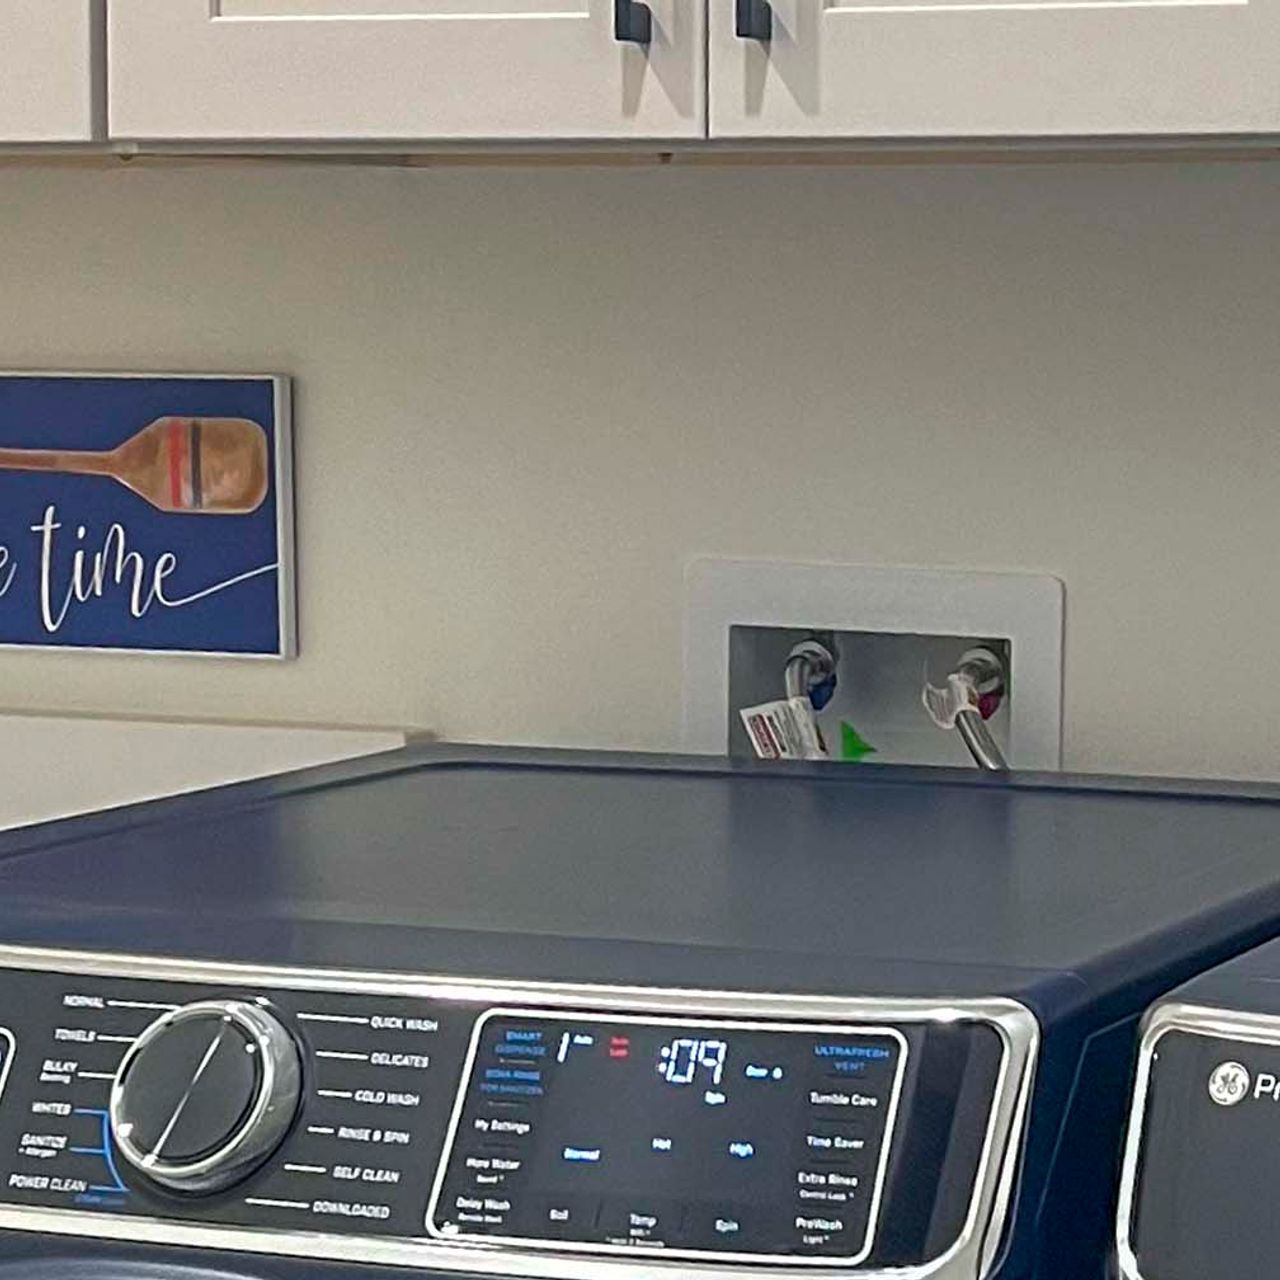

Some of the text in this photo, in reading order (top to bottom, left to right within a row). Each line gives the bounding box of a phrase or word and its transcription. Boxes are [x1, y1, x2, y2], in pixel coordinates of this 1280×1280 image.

[31, 505, 210, 633] time
[371, 1016, 438, 1032] QUICK WASH
[371, 1052, 429, 1069] DELICATES
[354, 1090, 420, 1106] COLD WASH
[810, 1091, 877, 1107] Tumble Care
[338, 1127, 371, 1142] RINSE
[383, 1130, 410, 1144] SPIN
[807, 1135, 865, 1149] Time Saver
[332, 1165, 400, 1183] SELF CLEAN
[798, 1171, 858, 1188] Extra Rinse
[9, 1174, 87, 1192] POWER CLEAN
[312, 1201, 390, 1219] DOWNLOADED
[796, 1216, 843, 1231] PreWash
